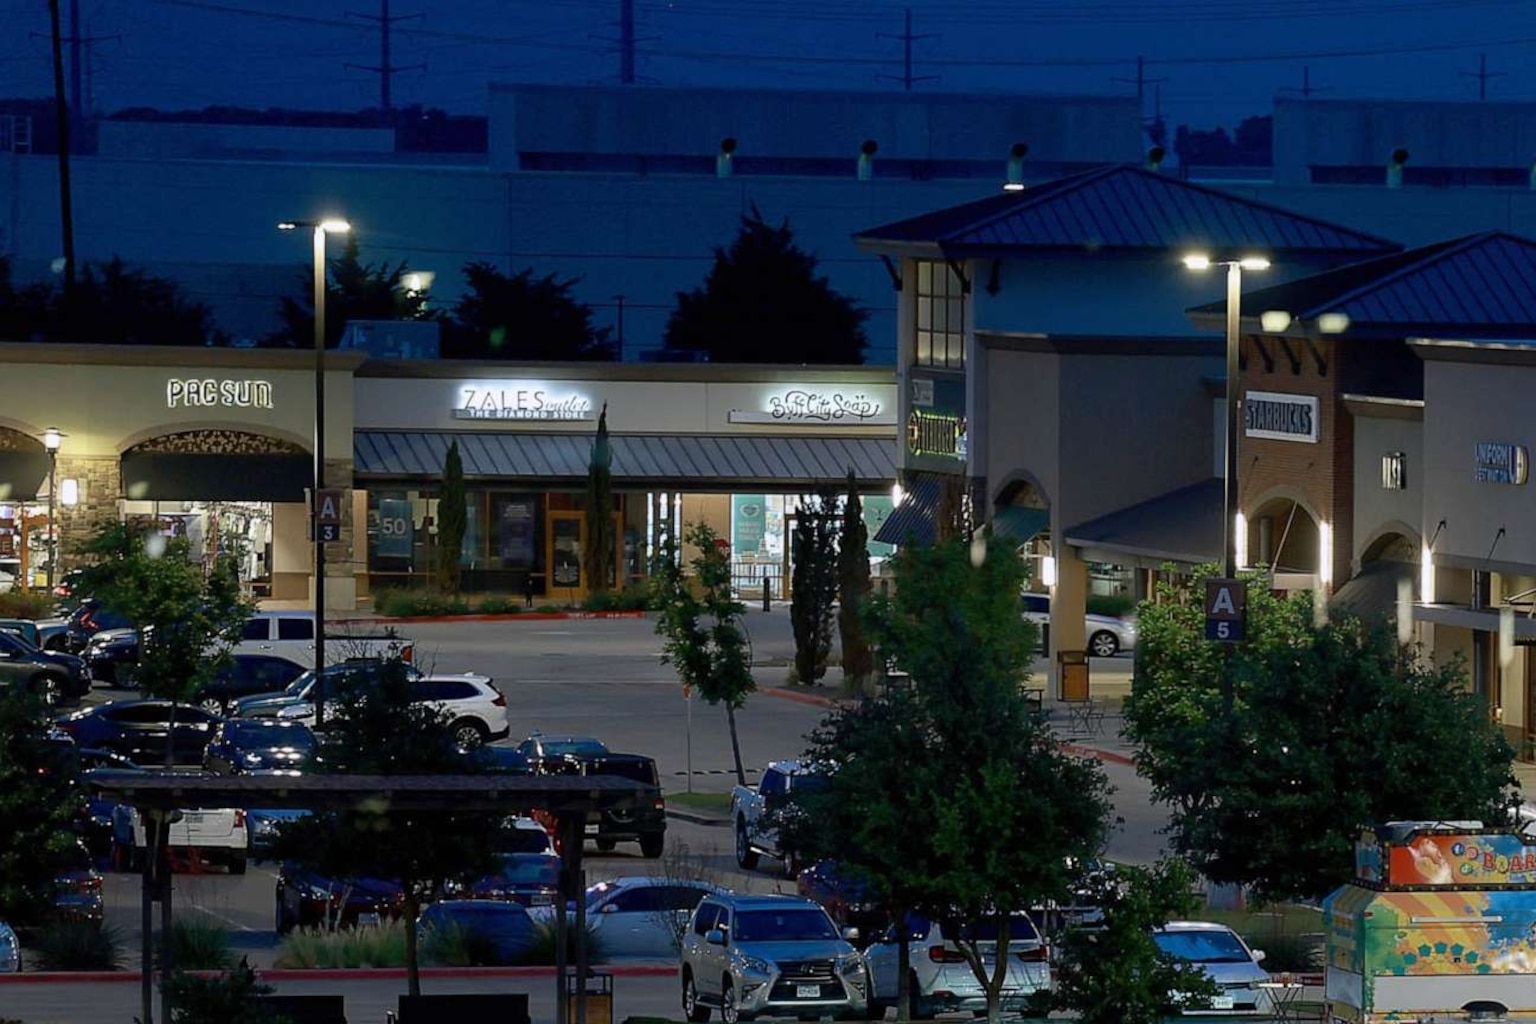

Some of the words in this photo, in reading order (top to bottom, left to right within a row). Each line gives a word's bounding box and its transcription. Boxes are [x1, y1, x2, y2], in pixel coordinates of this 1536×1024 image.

[464, 390, 545, 410] ZALES
[544, 396, 590, 411] outlet
[770, 391, 806, 420] Buff
[805, 393, 831, 421] City
[470, 410, 490, 418] THE
[496, 411, 547, 419] DIAMOND
[553, 411, 584, 419] STORE
[1245, 399, 1313, 435] STARBUCKS
[320, 496, 337, 519] A
[323, 525, 333, 540] 3
[1211, 587, 1236, 615] A
[1217, 621, 1230, 639] 5
